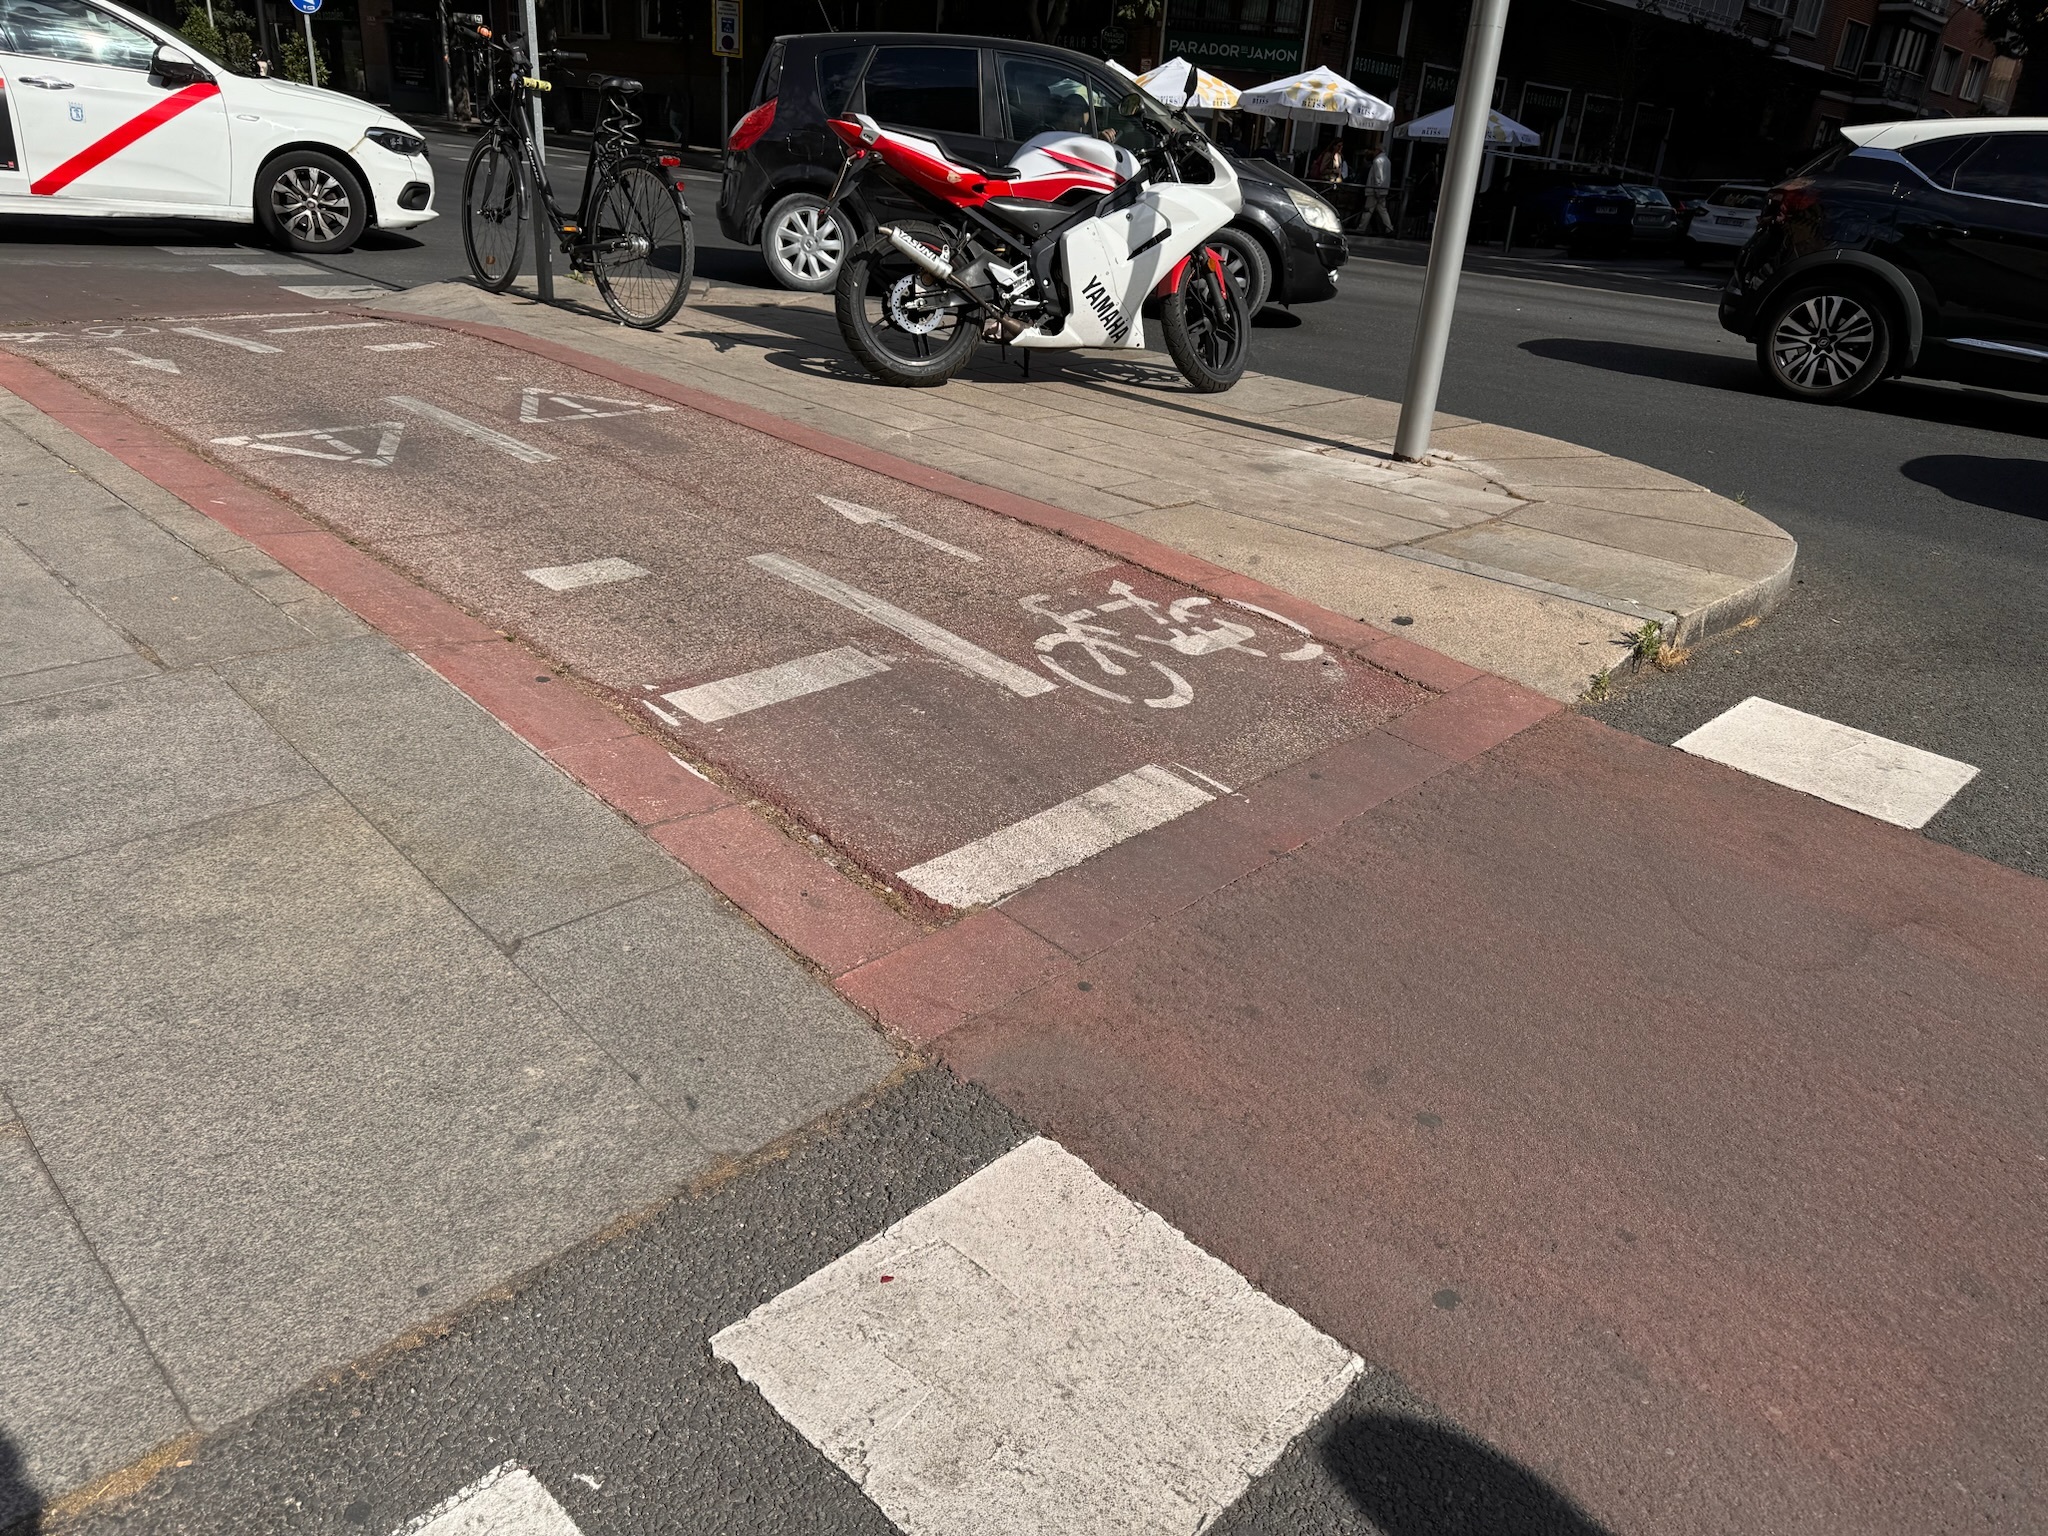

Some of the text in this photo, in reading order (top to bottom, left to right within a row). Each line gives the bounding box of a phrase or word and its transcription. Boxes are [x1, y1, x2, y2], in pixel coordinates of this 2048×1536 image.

[1169, 39, 1240, 58] PARADOR
[1247, 46, 1298, 62] JAMON
[1302, 100, 1326, 109] BLISS
[899, 229, 938, 263] YASUNI
[1081, 274, 1129, 344] YAMAHA
